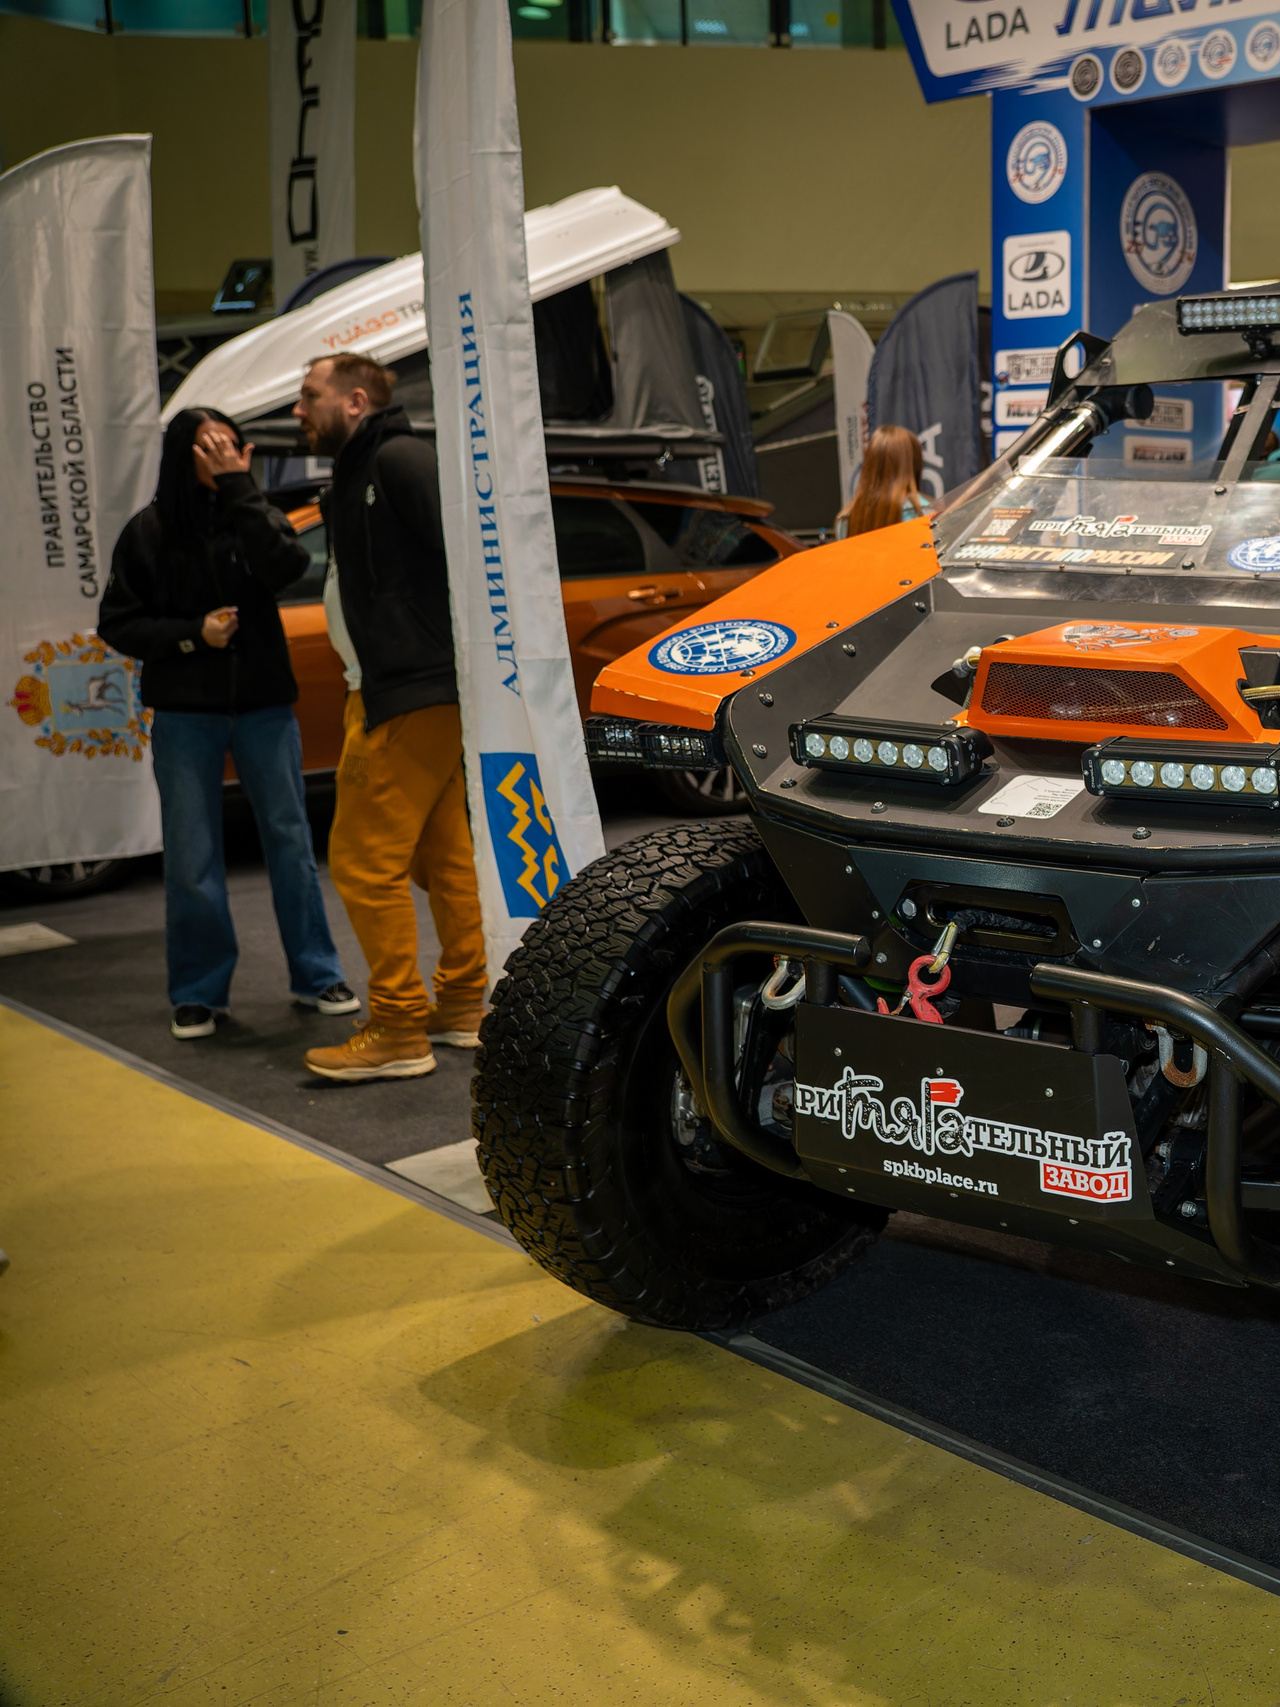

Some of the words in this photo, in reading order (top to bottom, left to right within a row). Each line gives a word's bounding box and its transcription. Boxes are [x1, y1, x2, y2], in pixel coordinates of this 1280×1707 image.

[944, 8, 1030, 50] LADA
[1008, 289, 1065, 313] LADA
[55, 346, 84, 455] ОБЛАСТИ
[27, 381, 66, 568] ПРАВИТЕЛЬСТВО
[457, 289, 521, 697] АДМИНИСТРАЦИЯ
[62, 459, 101, 599] САМАРСКОЙ
[1162, 535, 1204, 545] ЗАВОД
[883, 1158, 999, 1196] spkbplace.ru
[1045, 1164, 1128, 1198] ЗАВОД
